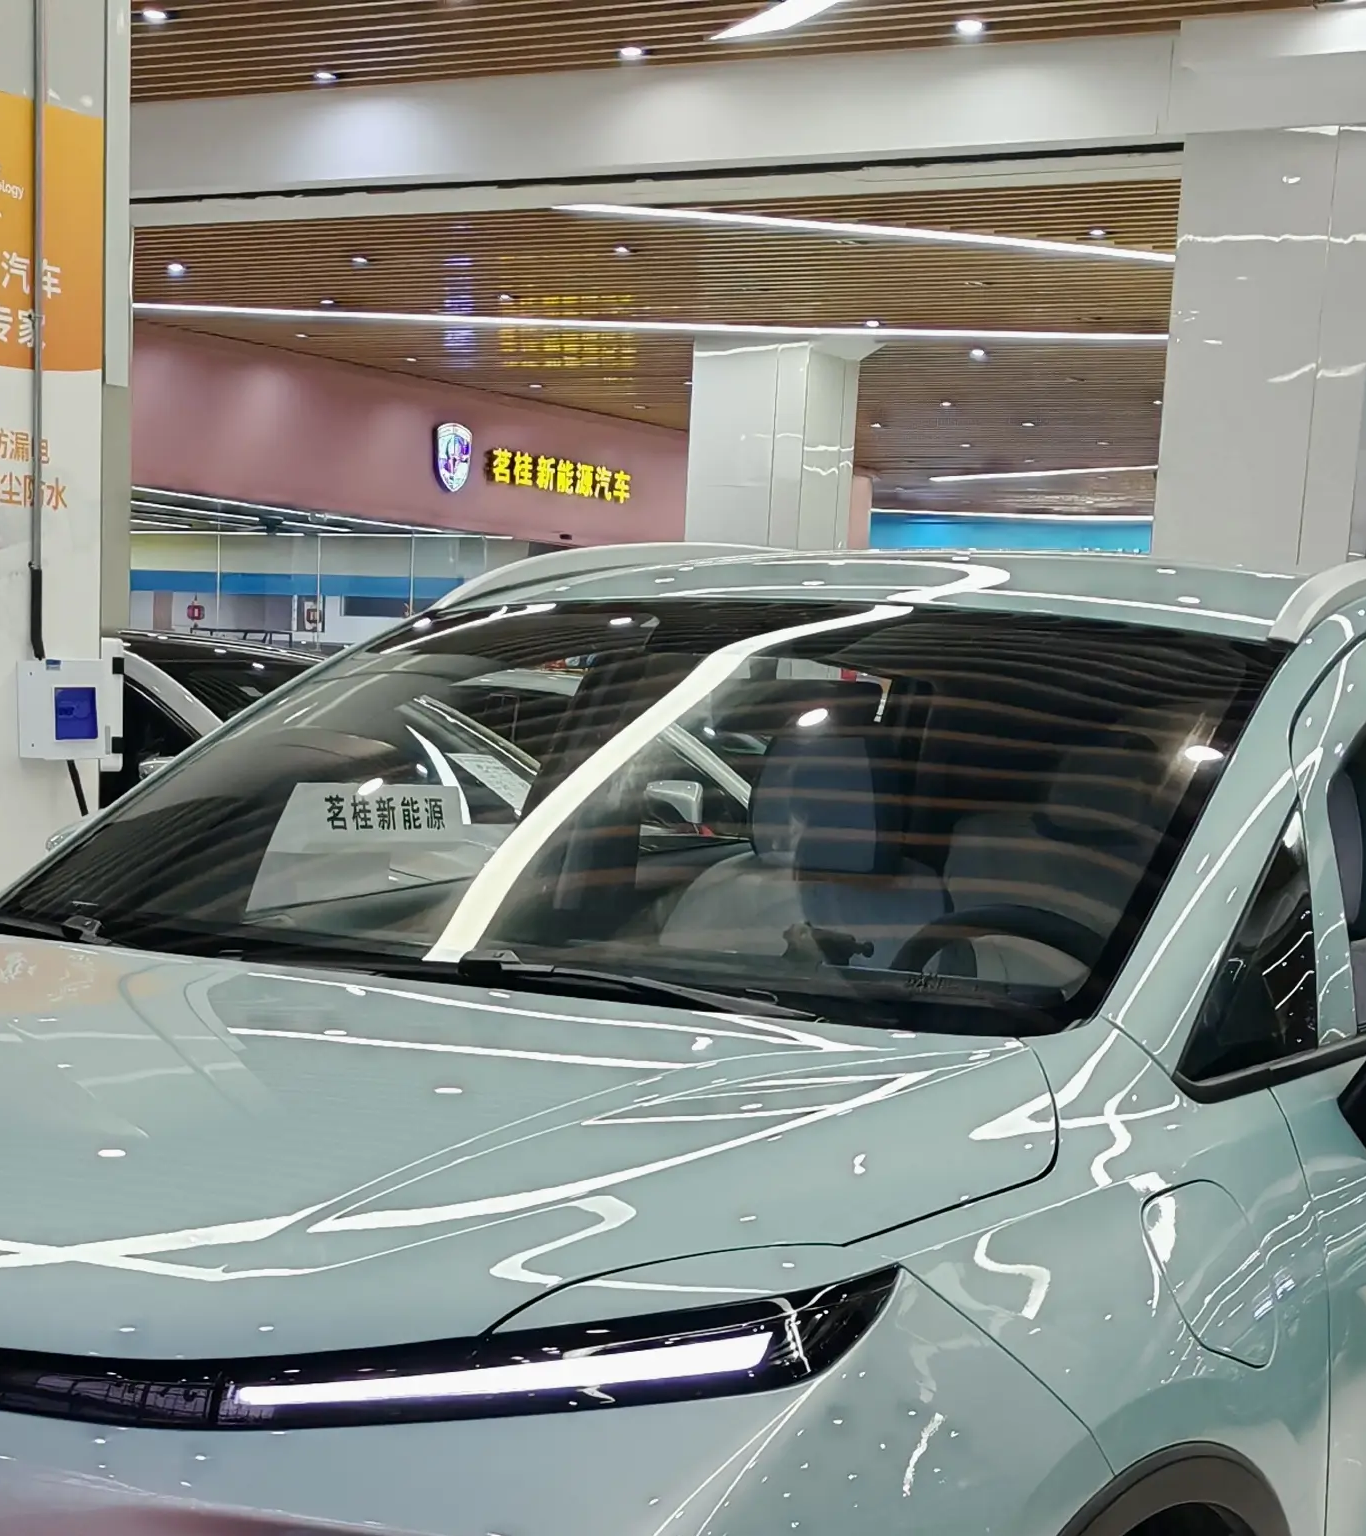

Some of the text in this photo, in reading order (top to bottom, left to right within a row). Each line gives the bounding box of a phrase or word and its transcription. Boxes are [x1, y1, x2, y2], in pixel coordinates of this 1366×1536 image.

[492, 447, 632, 504] 茗桂新能源汽车
[324, 794, 446, 832] 茗桂新能源
